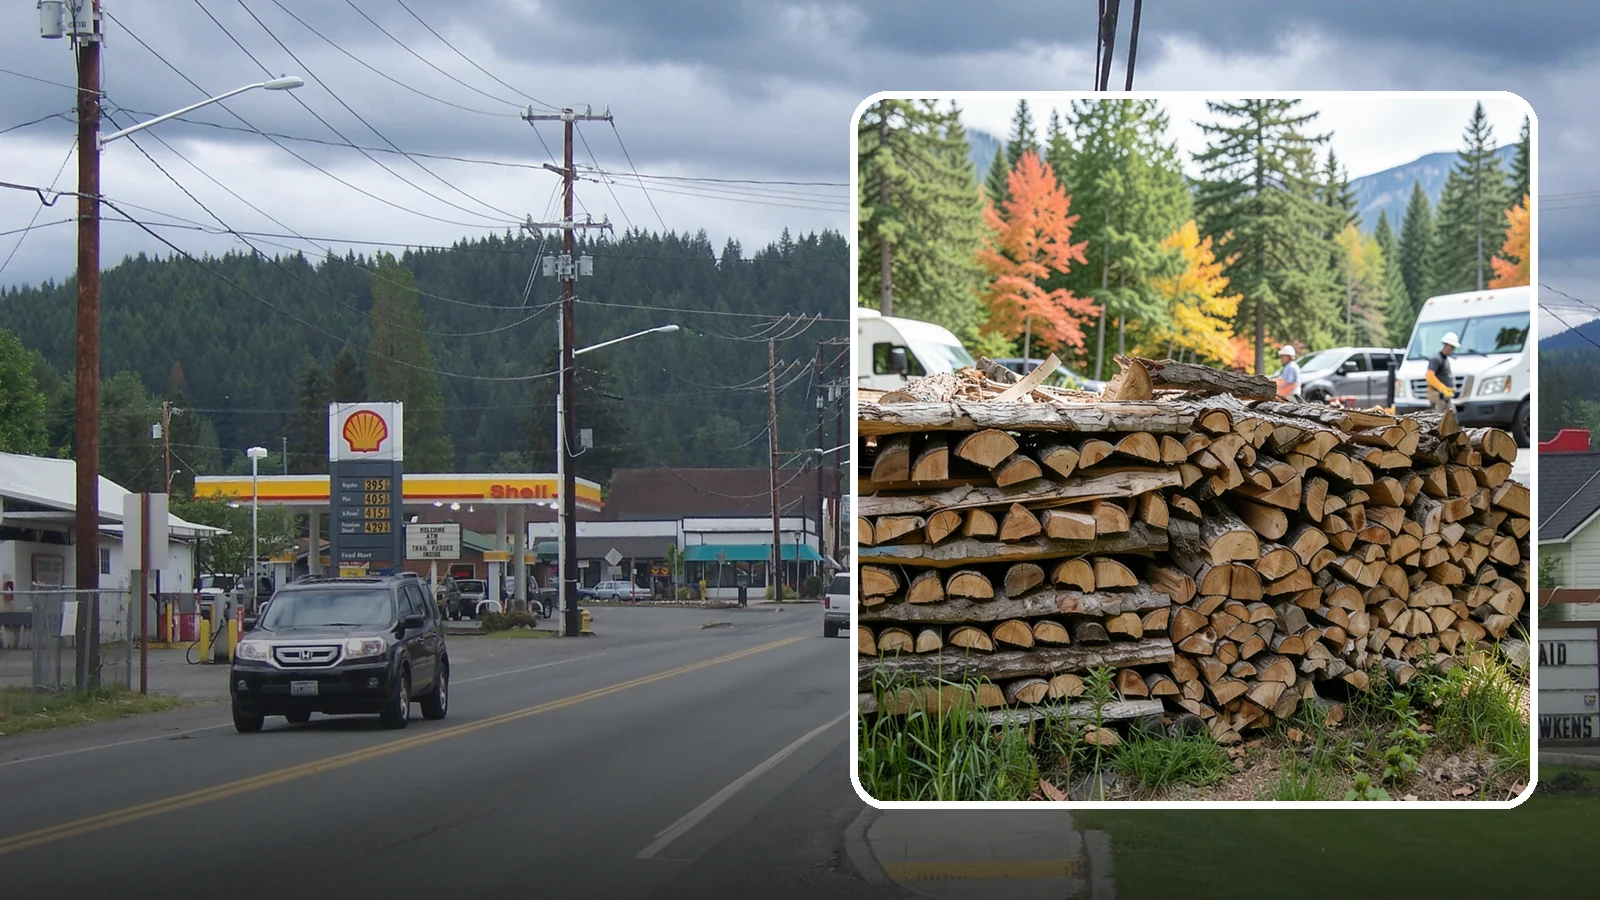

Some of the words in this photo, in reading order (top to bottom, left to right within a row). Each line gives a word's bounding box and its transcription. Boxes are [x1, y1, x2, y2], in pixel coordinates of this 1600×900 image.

[366, 480, 383, 490] 395
[490, 484, 547, 499] Shell
[366, 494, 383, 504] 405
[366, 508, 383, 518] 415
[366, 522, 383, 532] 429
